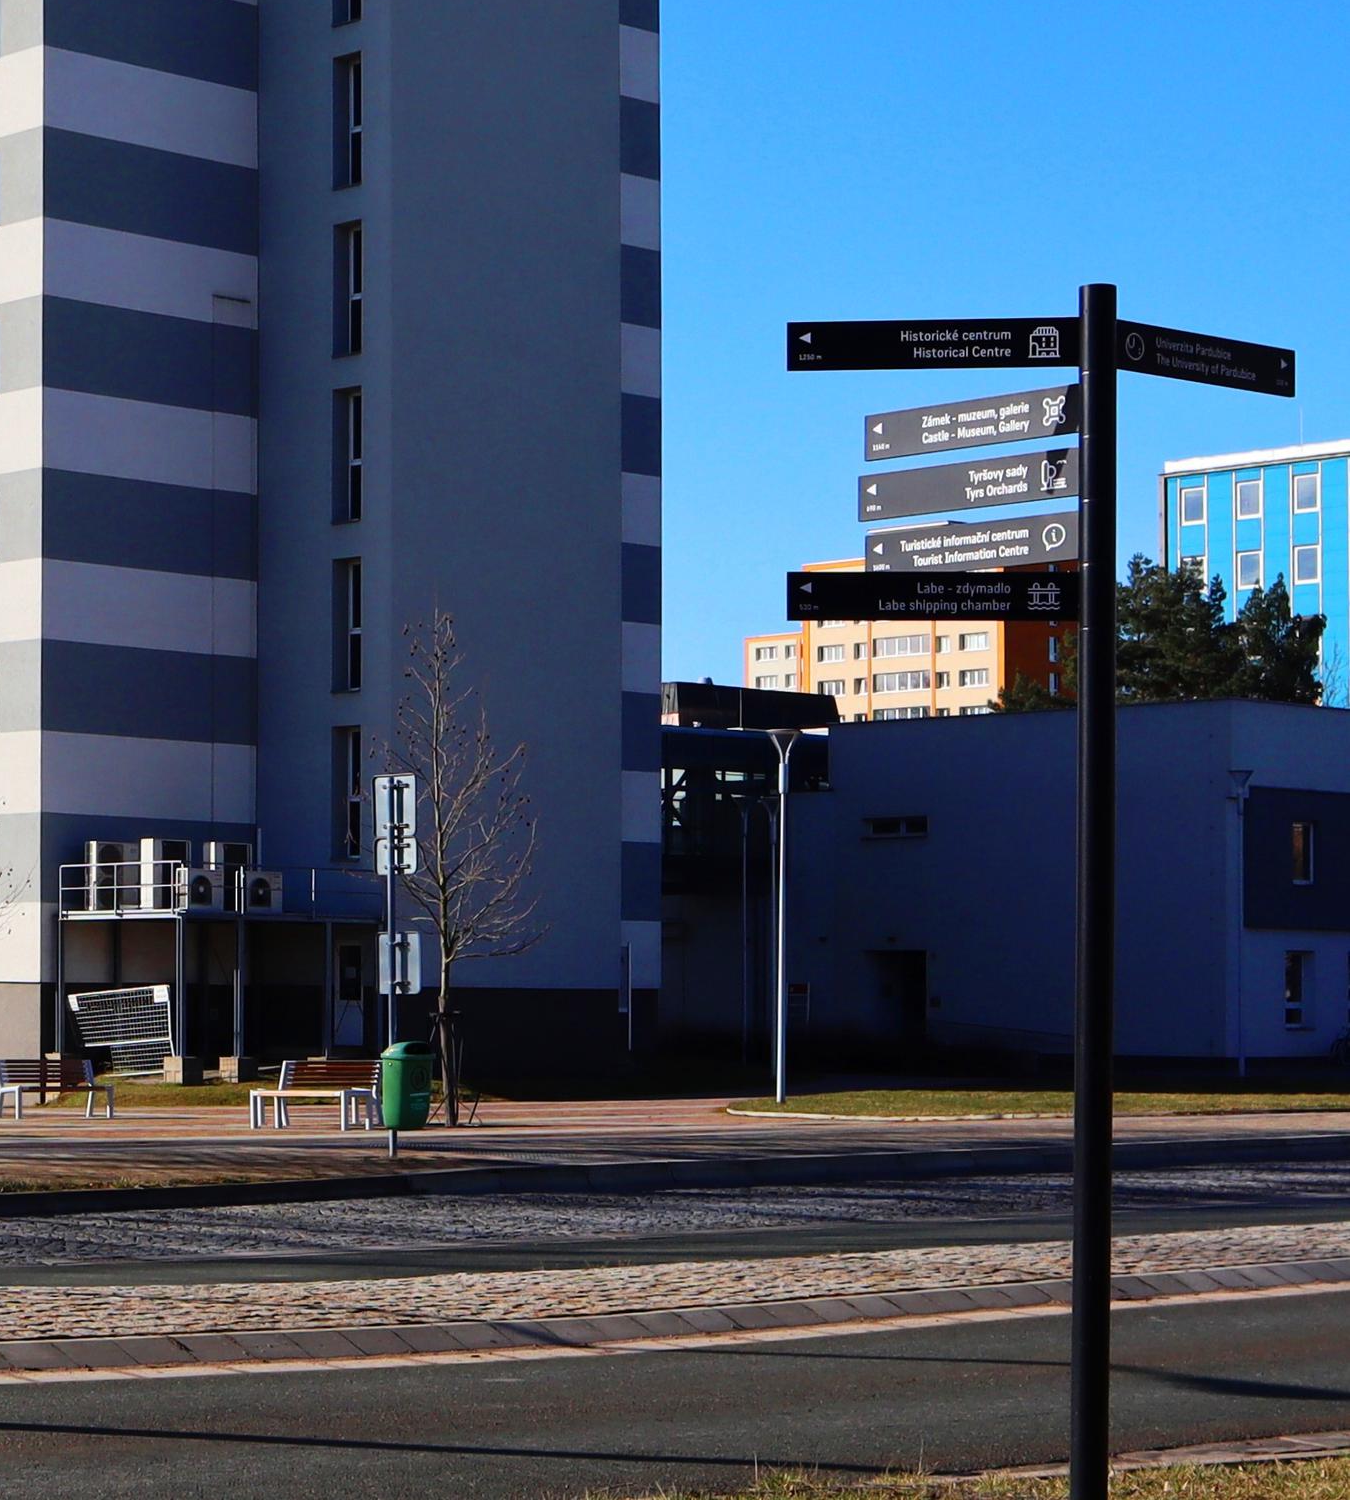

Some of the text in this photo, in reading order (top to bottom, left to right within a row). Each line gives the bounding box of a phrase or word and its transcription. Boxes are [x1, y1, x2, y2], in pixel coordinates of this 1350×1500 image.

[900, 329, 1012, 343] Historické centrum
[913, 346, 1012, 358] Historical Centre
[1156, 353, 1257, 381] The University of Pardubice
[921, 413, 951, 429] Zámek
[958, 409, 998, 424] muzeum,
[999, 402, 1030, 421] galerie
[921, 429, 950, 445] Castle
[957, 423, 998, 440] Museum,
[999, 419, 1030, 437] Gallery
[968, 464, 1028, 485] Tyršovy sady
[964, 481, 1028, 502] Tyrs Orchards
[900, 528, 1030, 552] Turistické informační centrum
[912, 545, 1030, 567] Tourist Information Centre
[917, 582, 944, 594] Labe
[956, 582, 1011, 596] zdymadlo
[878, 599, 1011, 613] Labe shipping chamber
